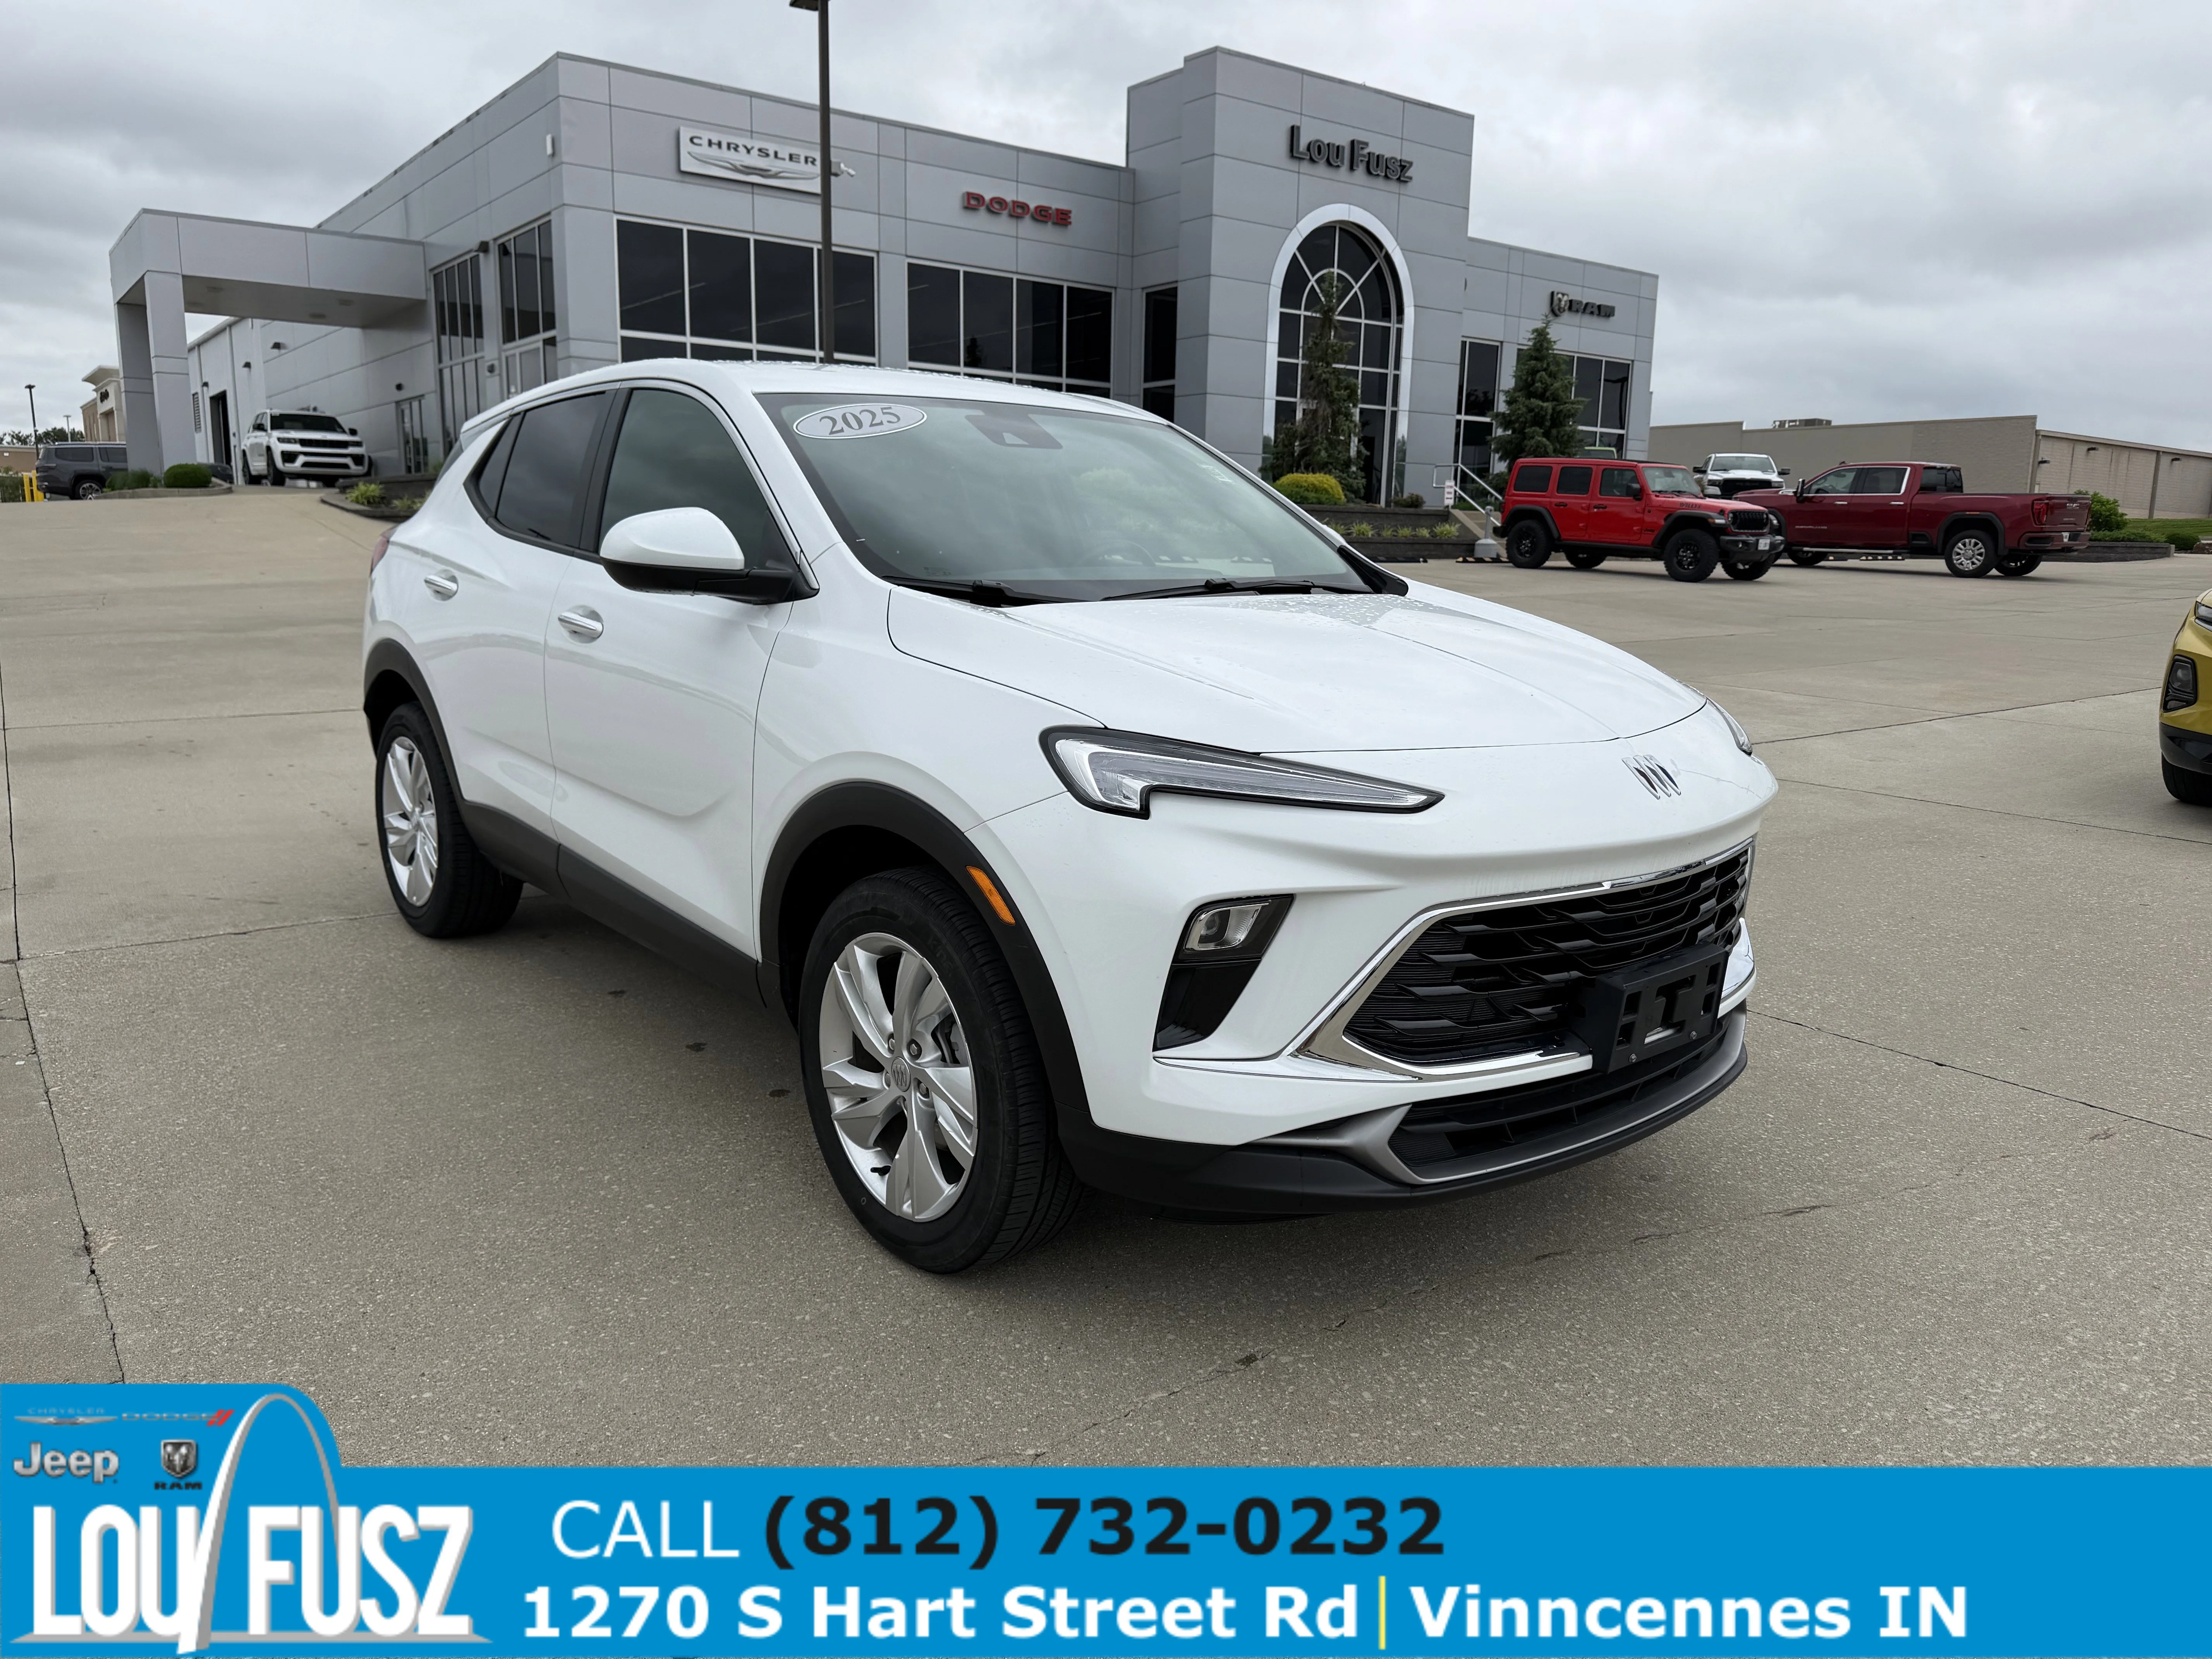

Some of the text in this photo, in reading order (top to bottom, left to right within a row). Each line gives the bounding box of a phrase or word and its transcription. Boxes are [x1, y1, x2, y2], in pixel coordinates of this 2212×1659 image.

[689, 136, 817, 166] CHRYSLER
[1290, 125, 1413, 182] Lou Fusz
[963, 191, 1072, 225] DODGE
[1568, 299, 1616, 318] RAM
[819, 406, 900, 435] 2025
